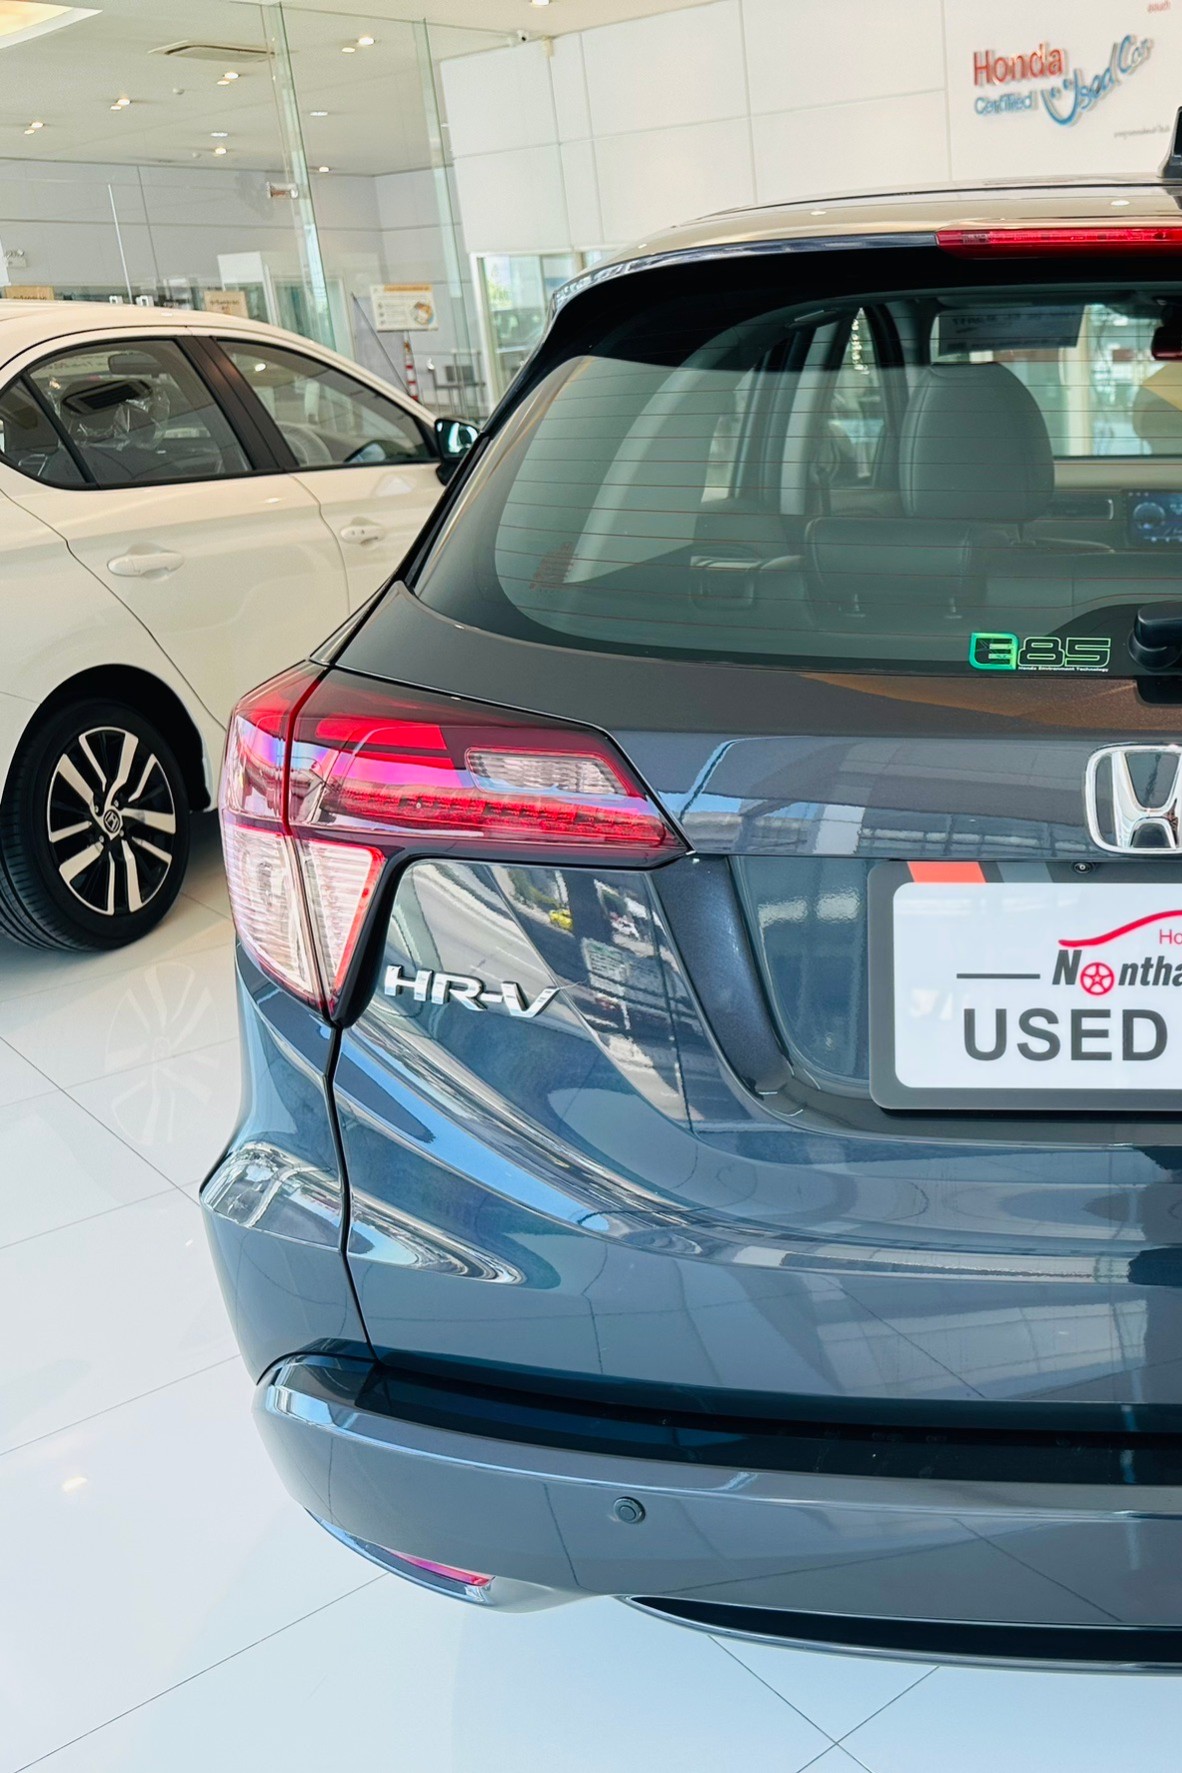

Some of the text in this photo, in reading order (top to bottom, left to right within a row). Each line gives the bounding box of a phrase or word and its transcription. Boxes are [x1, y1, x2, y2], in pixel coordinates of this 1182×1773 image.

[973, 43, 1063, 86] Honda
[974, 90, 1033, 116] Certified
[969, 632, 1112, 671] E85
[384, 964, 560, 1019] HR-V
[963, 1007, 1169, 1062] USED
